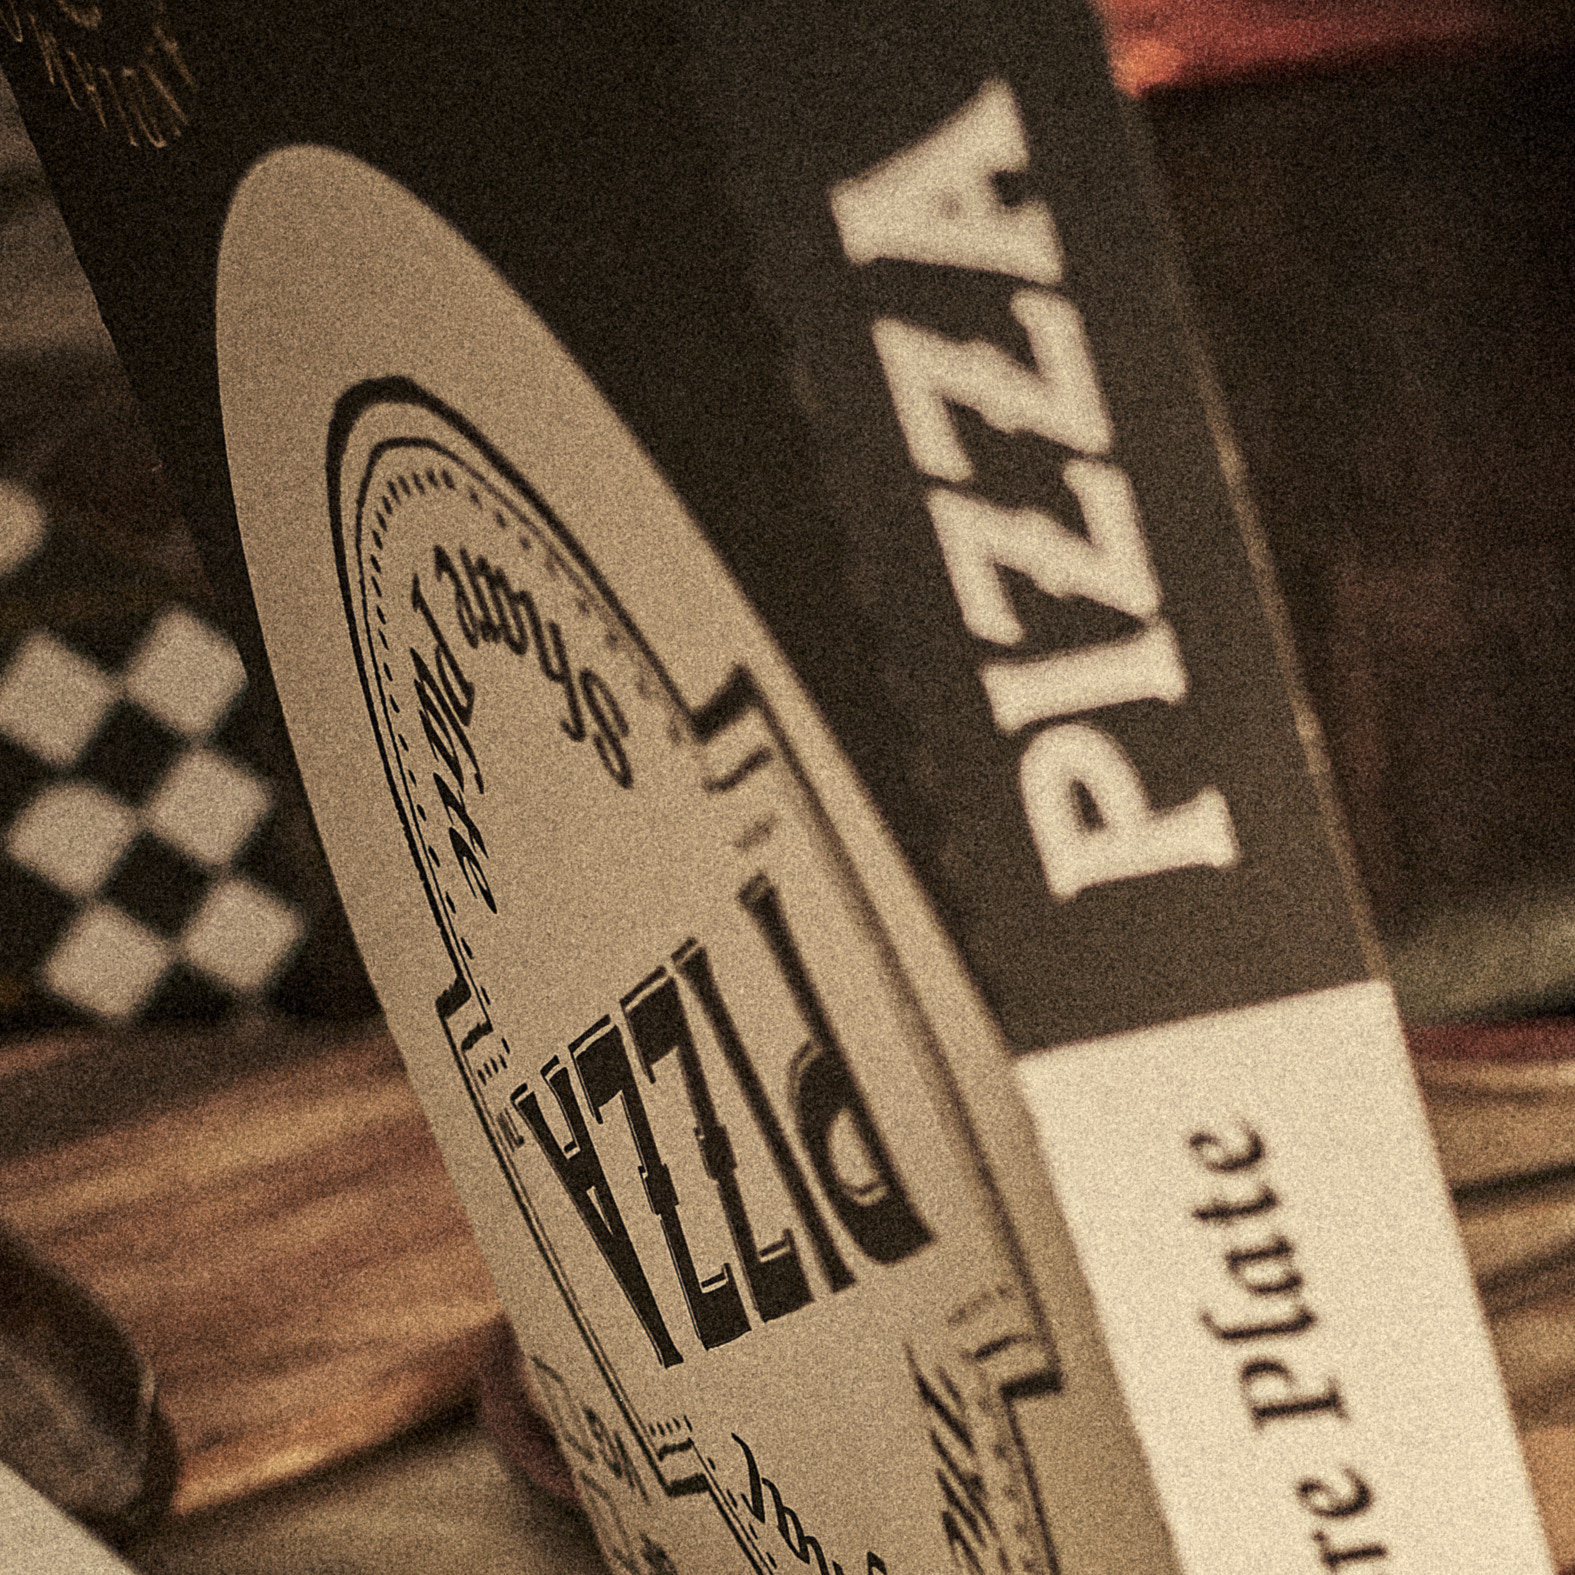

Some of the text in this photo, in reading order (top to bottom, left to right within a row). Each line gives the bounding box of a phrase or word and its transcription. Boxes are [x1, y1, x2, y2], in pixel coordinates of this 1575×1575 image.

[831, 76, 1240, 899] PIZZA
[410, 545, 633, 915] Share Plate
[1190, 1117, 1350, 1431] Plate
